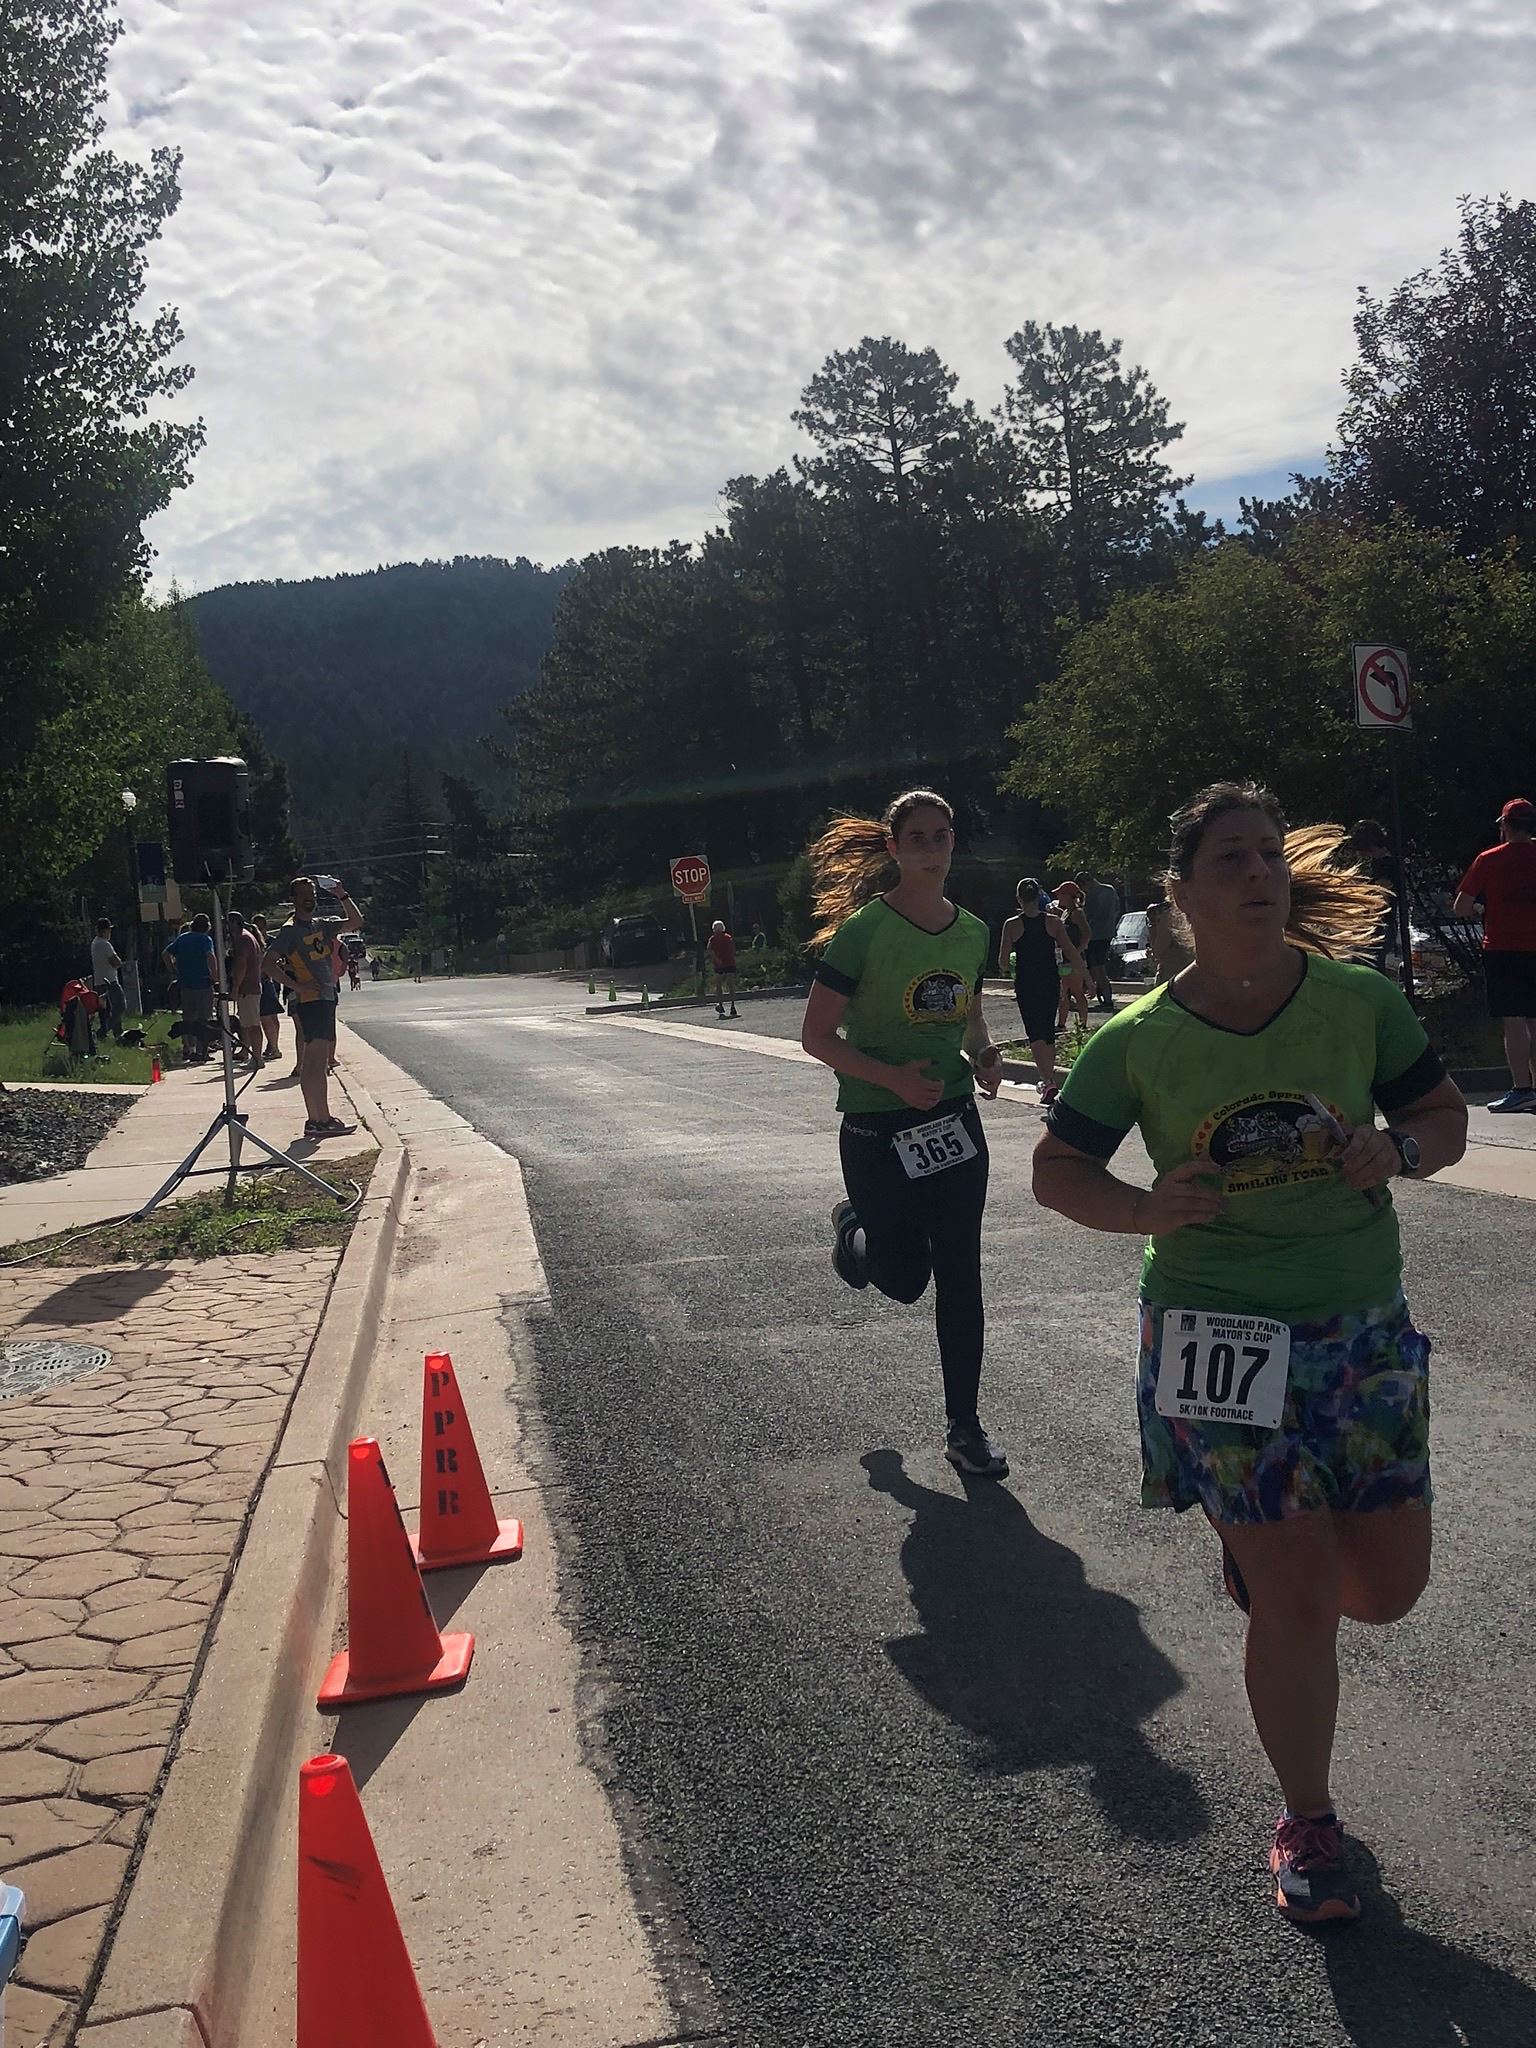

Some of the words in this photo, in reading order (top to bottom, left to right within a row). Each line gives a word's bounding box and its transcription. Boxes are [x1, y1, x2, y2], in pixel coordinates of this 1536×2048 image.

[675, 867, 707, 885] STOP
[1213, 1092, 1265, 1121] Colorado
[1268, 1090, 1309, 1104] Sprin
[909, 1131, 964, 1170] 365
[1227, 1172, 1288, 1193] SMILING
[1291, 1167, 1329, 1182] TOAD
[1206, 1316, 1255, 1330] WOODLAND
[1257, 1321, 1281, 1335] PARK
[1212, 1328, 1251, 1341] MAYOR'S
[1253, 1332, 1273, 1344] CUP
[1176, 1341, 1270, 1405] 107
[1179, 1404, 1208, 1417] 5K/10K
[1210, 1406, 1254, 1421] FOOTRACE
